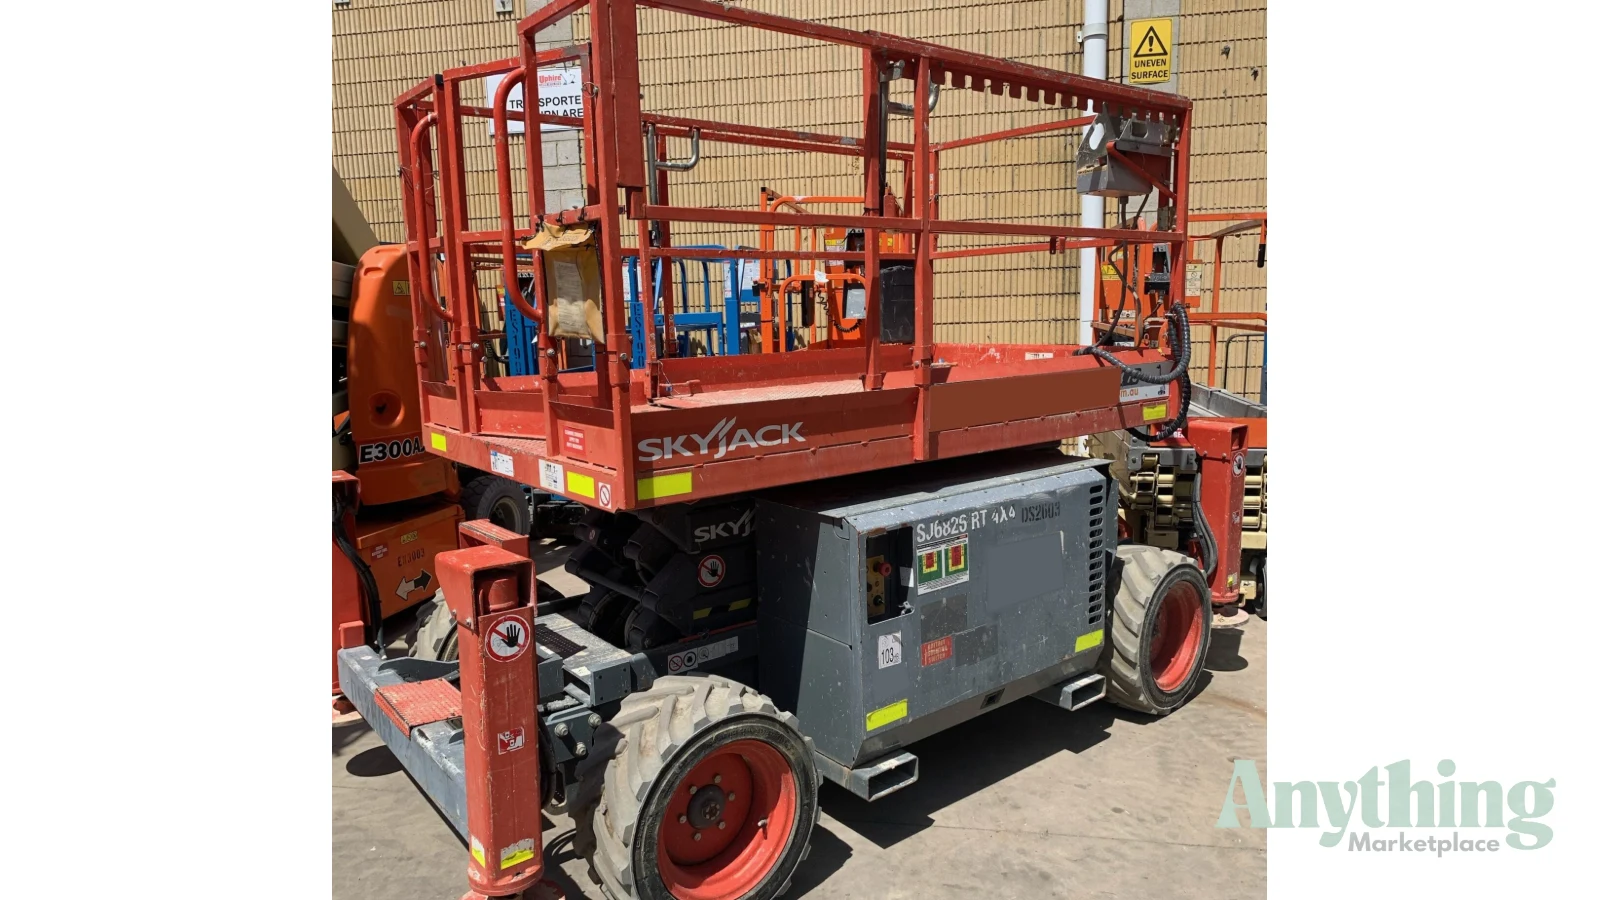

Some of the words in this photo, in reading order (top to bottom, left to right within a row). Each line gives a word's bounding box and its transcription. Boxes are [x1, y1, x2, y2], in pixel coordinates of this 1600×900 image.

[1134, 58, 1167, 68] UNEVEN
[1131, 69, 1169, 80] SURFACE
[637, 416, 806, 462] SKYJACK
[971, 508, 988, 530] RT
[881, 647, 894, 665] 103
